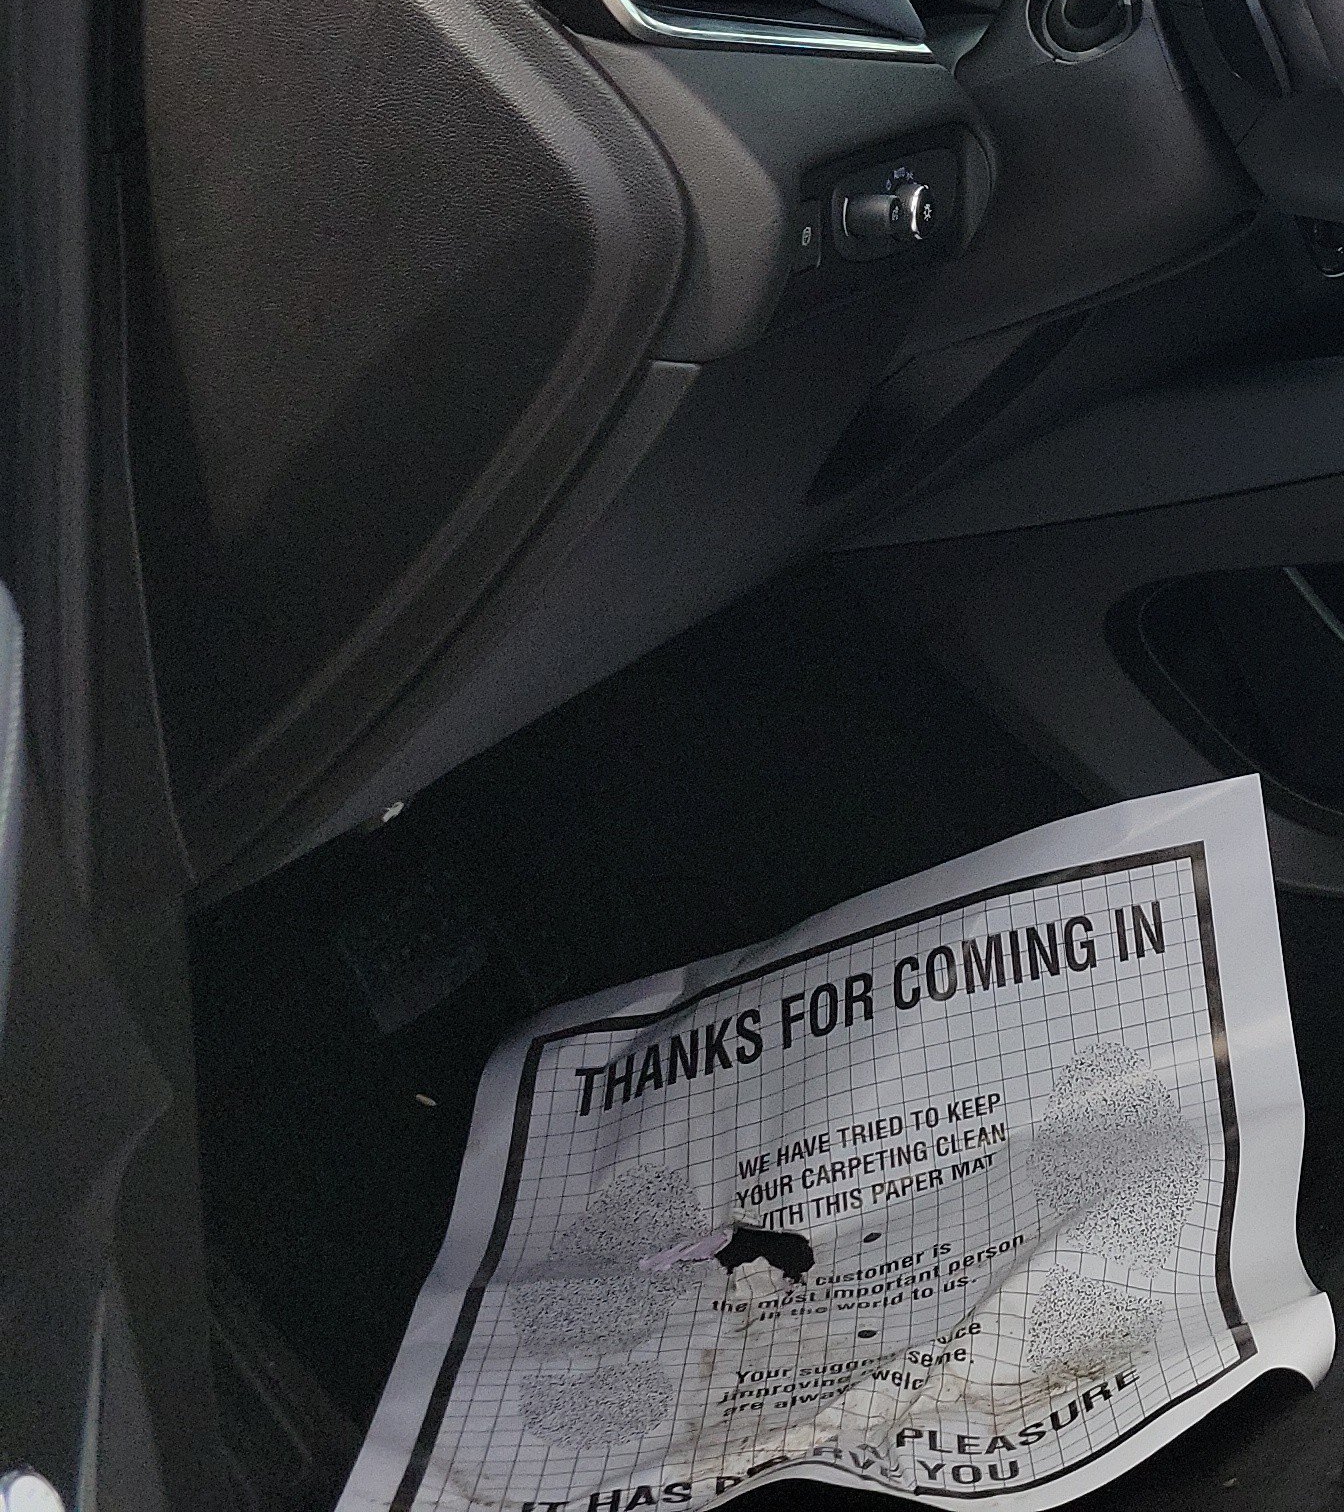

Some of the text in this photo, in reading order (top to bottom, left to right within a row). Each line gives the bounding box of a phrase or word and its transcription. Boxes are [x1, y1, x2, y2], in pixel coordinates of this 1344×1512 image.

[575, 900, 1166, 1117] THANKS FOR COMING IN
[736, 1122, 1007, 1209] YOUR CARPETING CLEAN
[738, 1092, 1001, 1180] WE HAVE TRIED TO KEEP
[810, 1188, 864, 1220] THIS
[871, 1168, 944, 1205] PAPER
[951, 1153, 998, 1181] MAT
[712, 1234, 1025, 1315] the most important person
[759, 1310, 781, 1322] in
[837, 1293, 903, 1311] world
[912, 1286, 933, 1301] to
[943, 1275, 978, 1293] us.
[815, 1242, 952, 1288] customer is
[722, 1400, 764, 1418] are
[736, 1368, 791, 1385] Your
[587, 1368, 1142, 1512] HAS PLEASURE
[921, 1458, 1022, 1486] YOU
